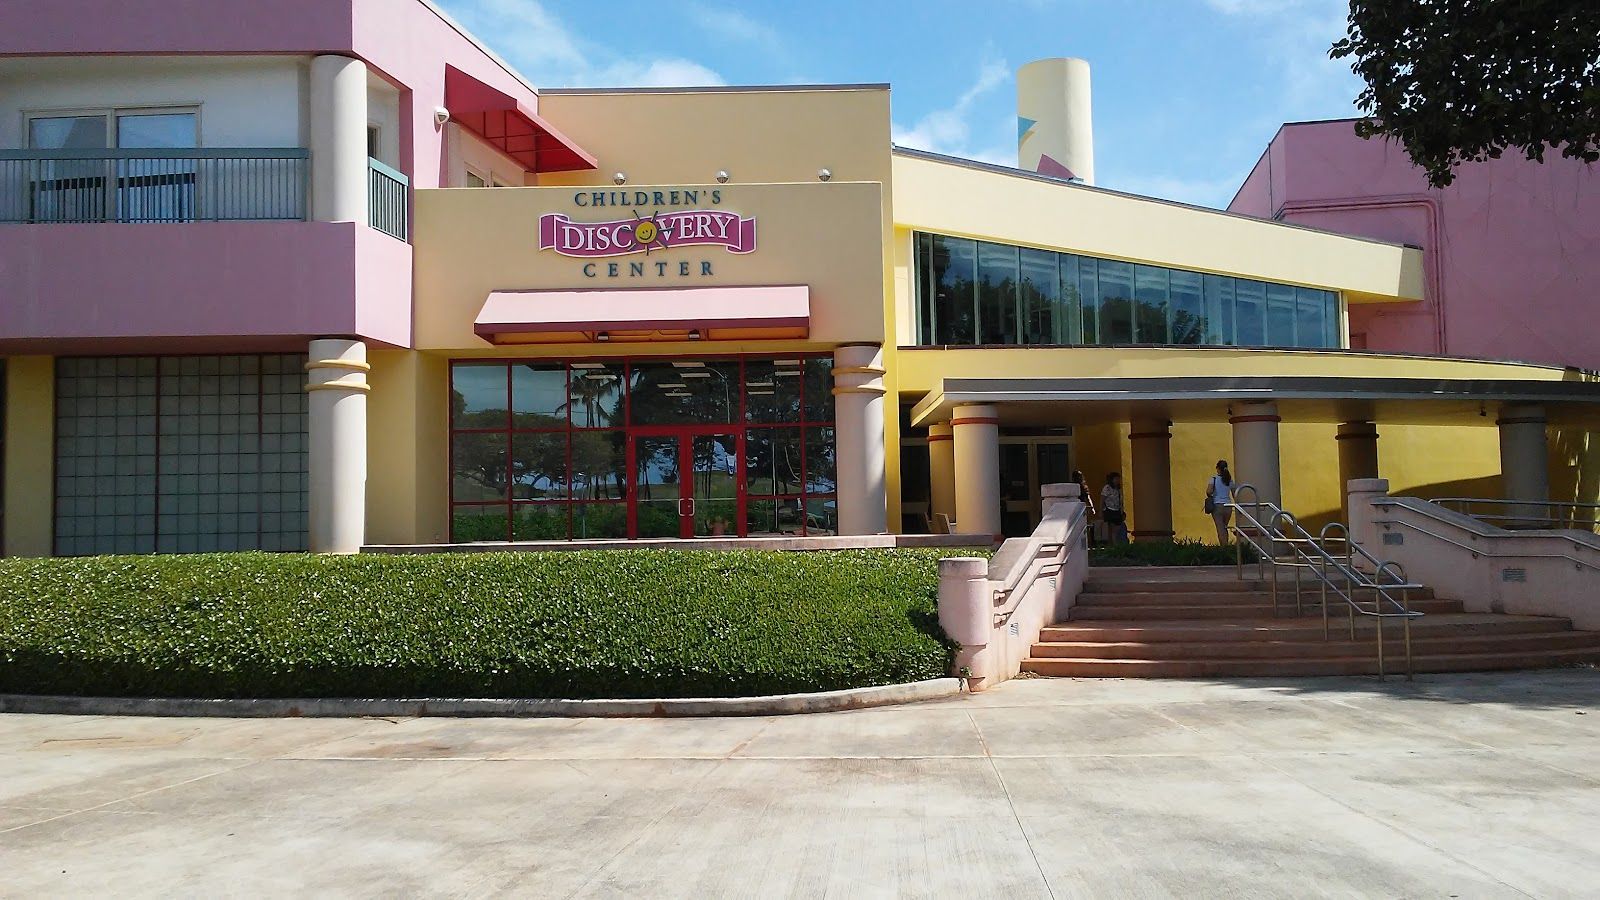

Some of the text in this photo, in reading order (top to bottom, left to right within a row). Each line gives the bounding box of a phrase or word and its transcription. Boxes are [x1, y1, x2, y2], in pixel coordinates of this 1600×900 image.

[574, 190, 721, 207] CHILDREN'S
[561, 214, 735, 251] DISCOVERY
[583, 261, 713, 278] CENTER
